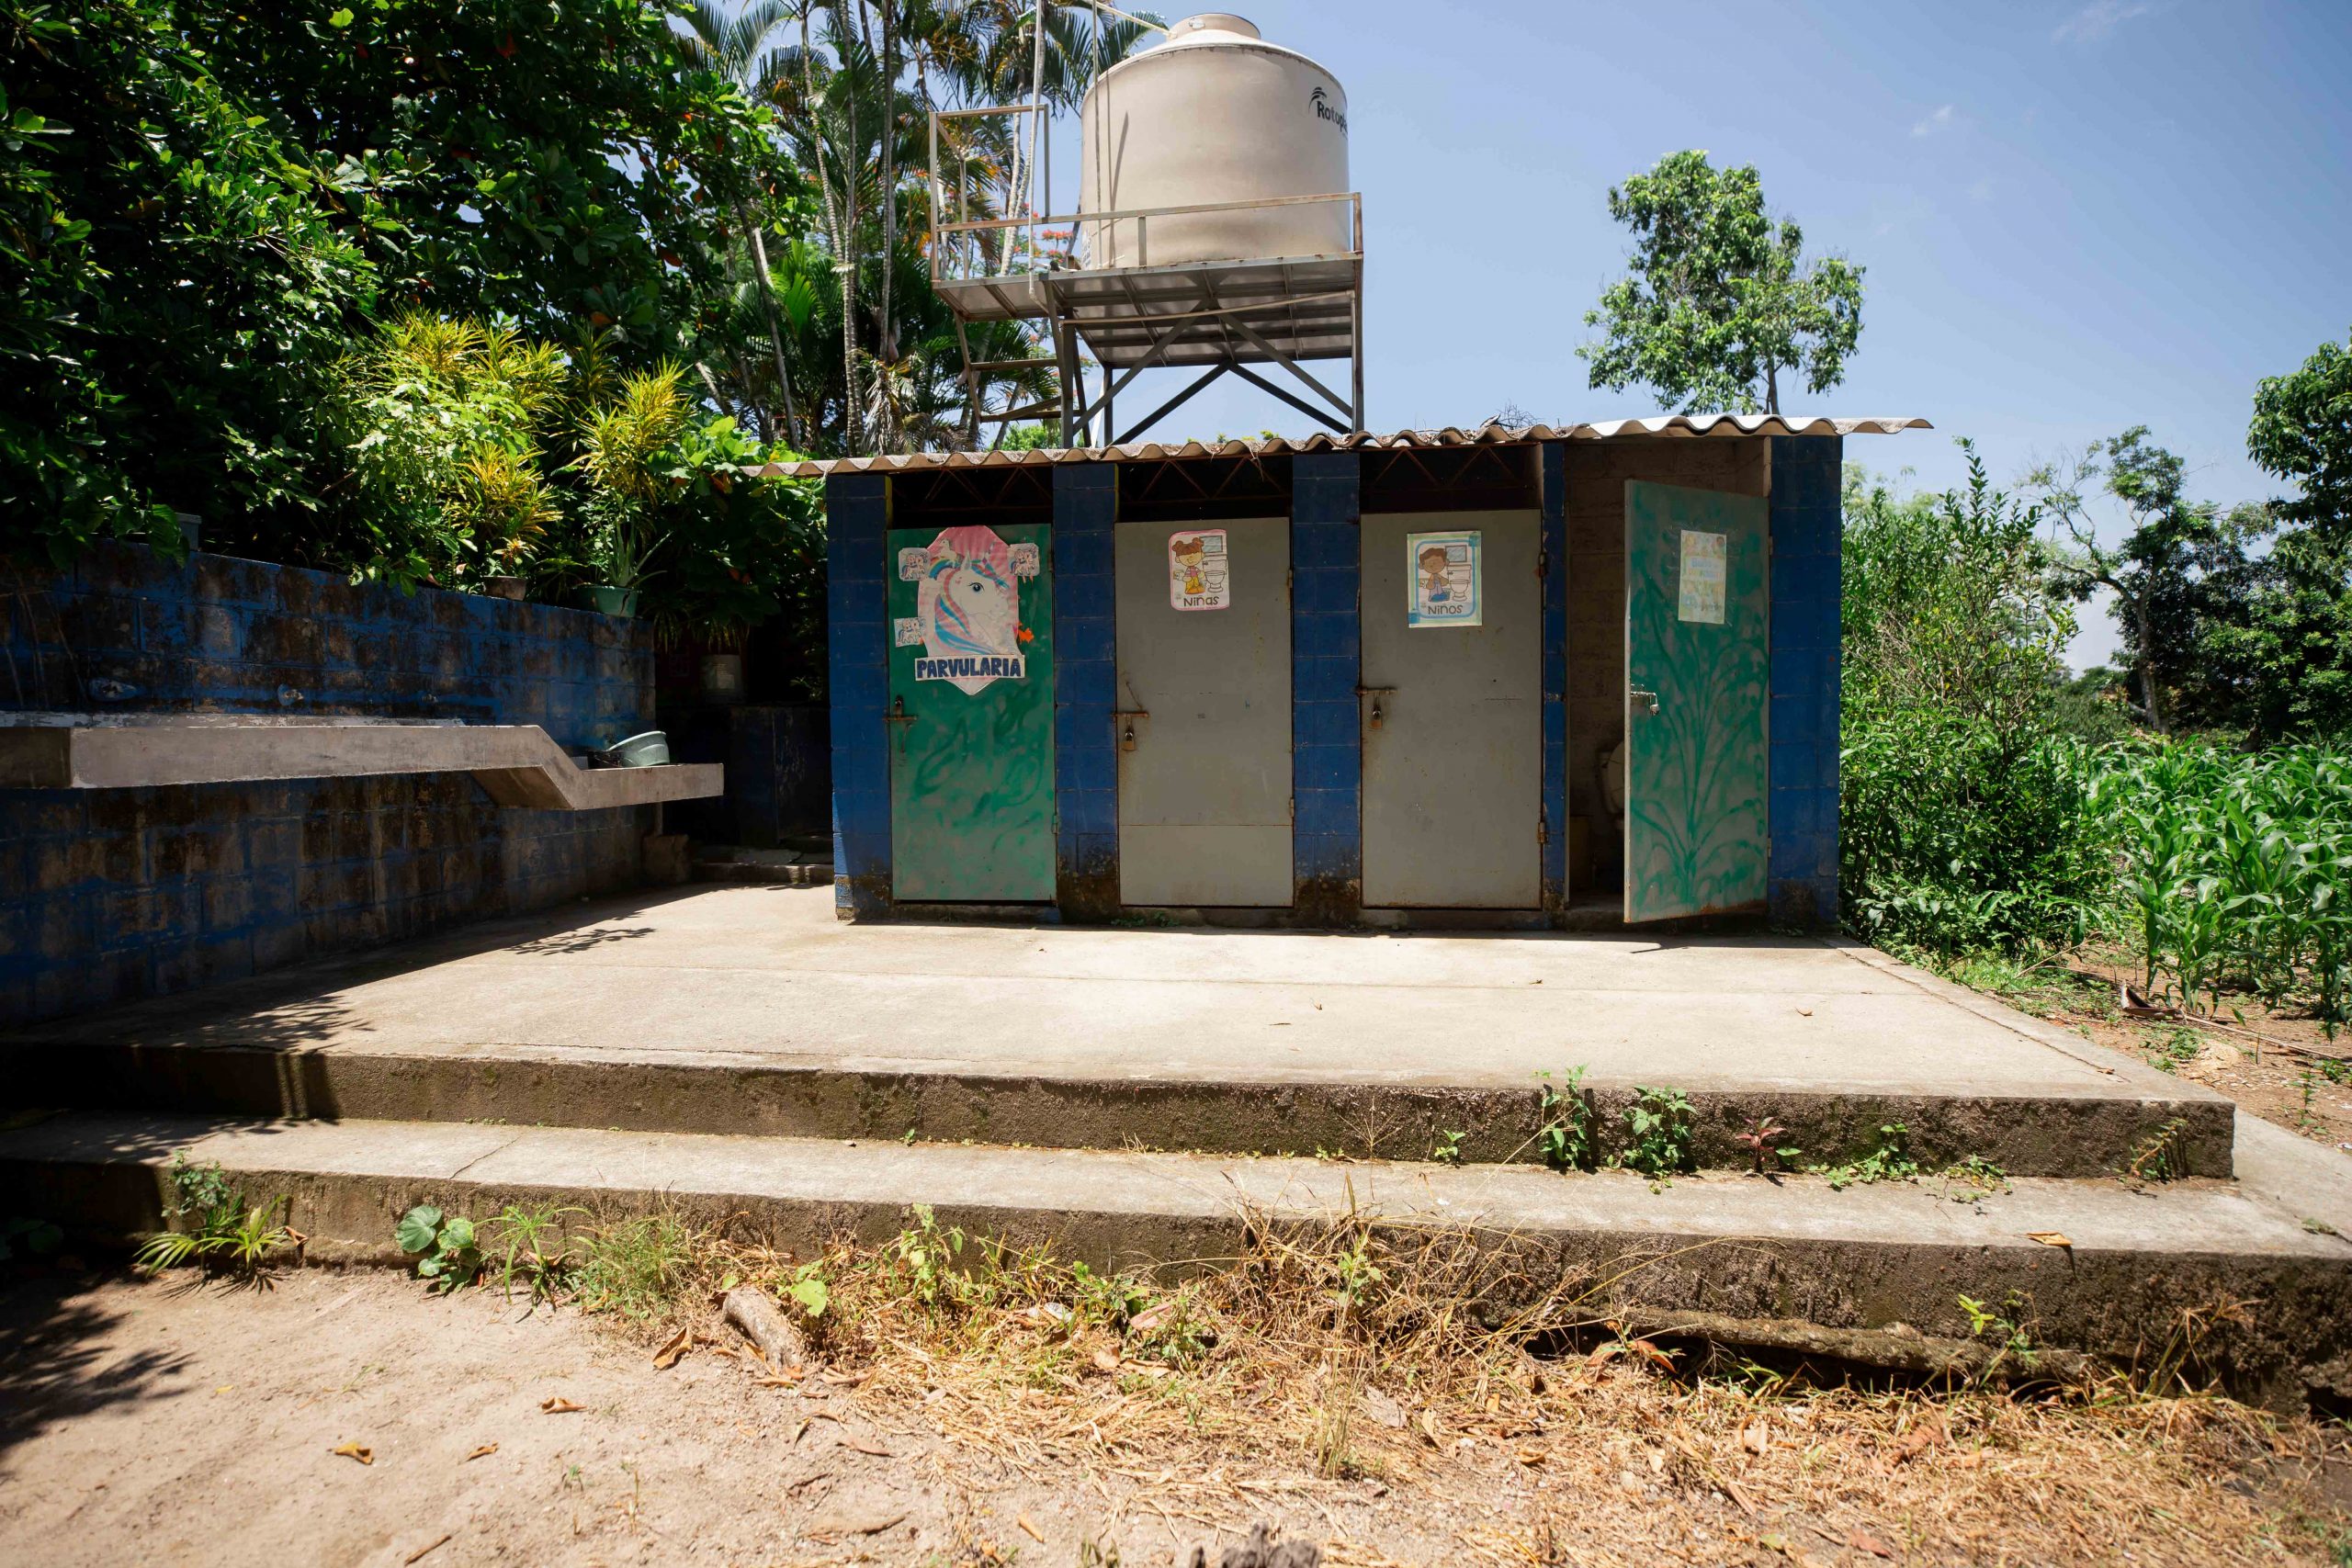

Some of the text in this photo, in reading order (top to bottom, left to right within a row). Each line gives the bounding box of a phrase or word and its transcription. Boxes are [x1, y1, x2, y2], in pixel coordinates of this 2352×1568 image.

[1183, 595, 1220, 607] Niñas
[1428, 604, 1464, 615] Niños
[916, 657, 1022, 678] PARVULARIA
